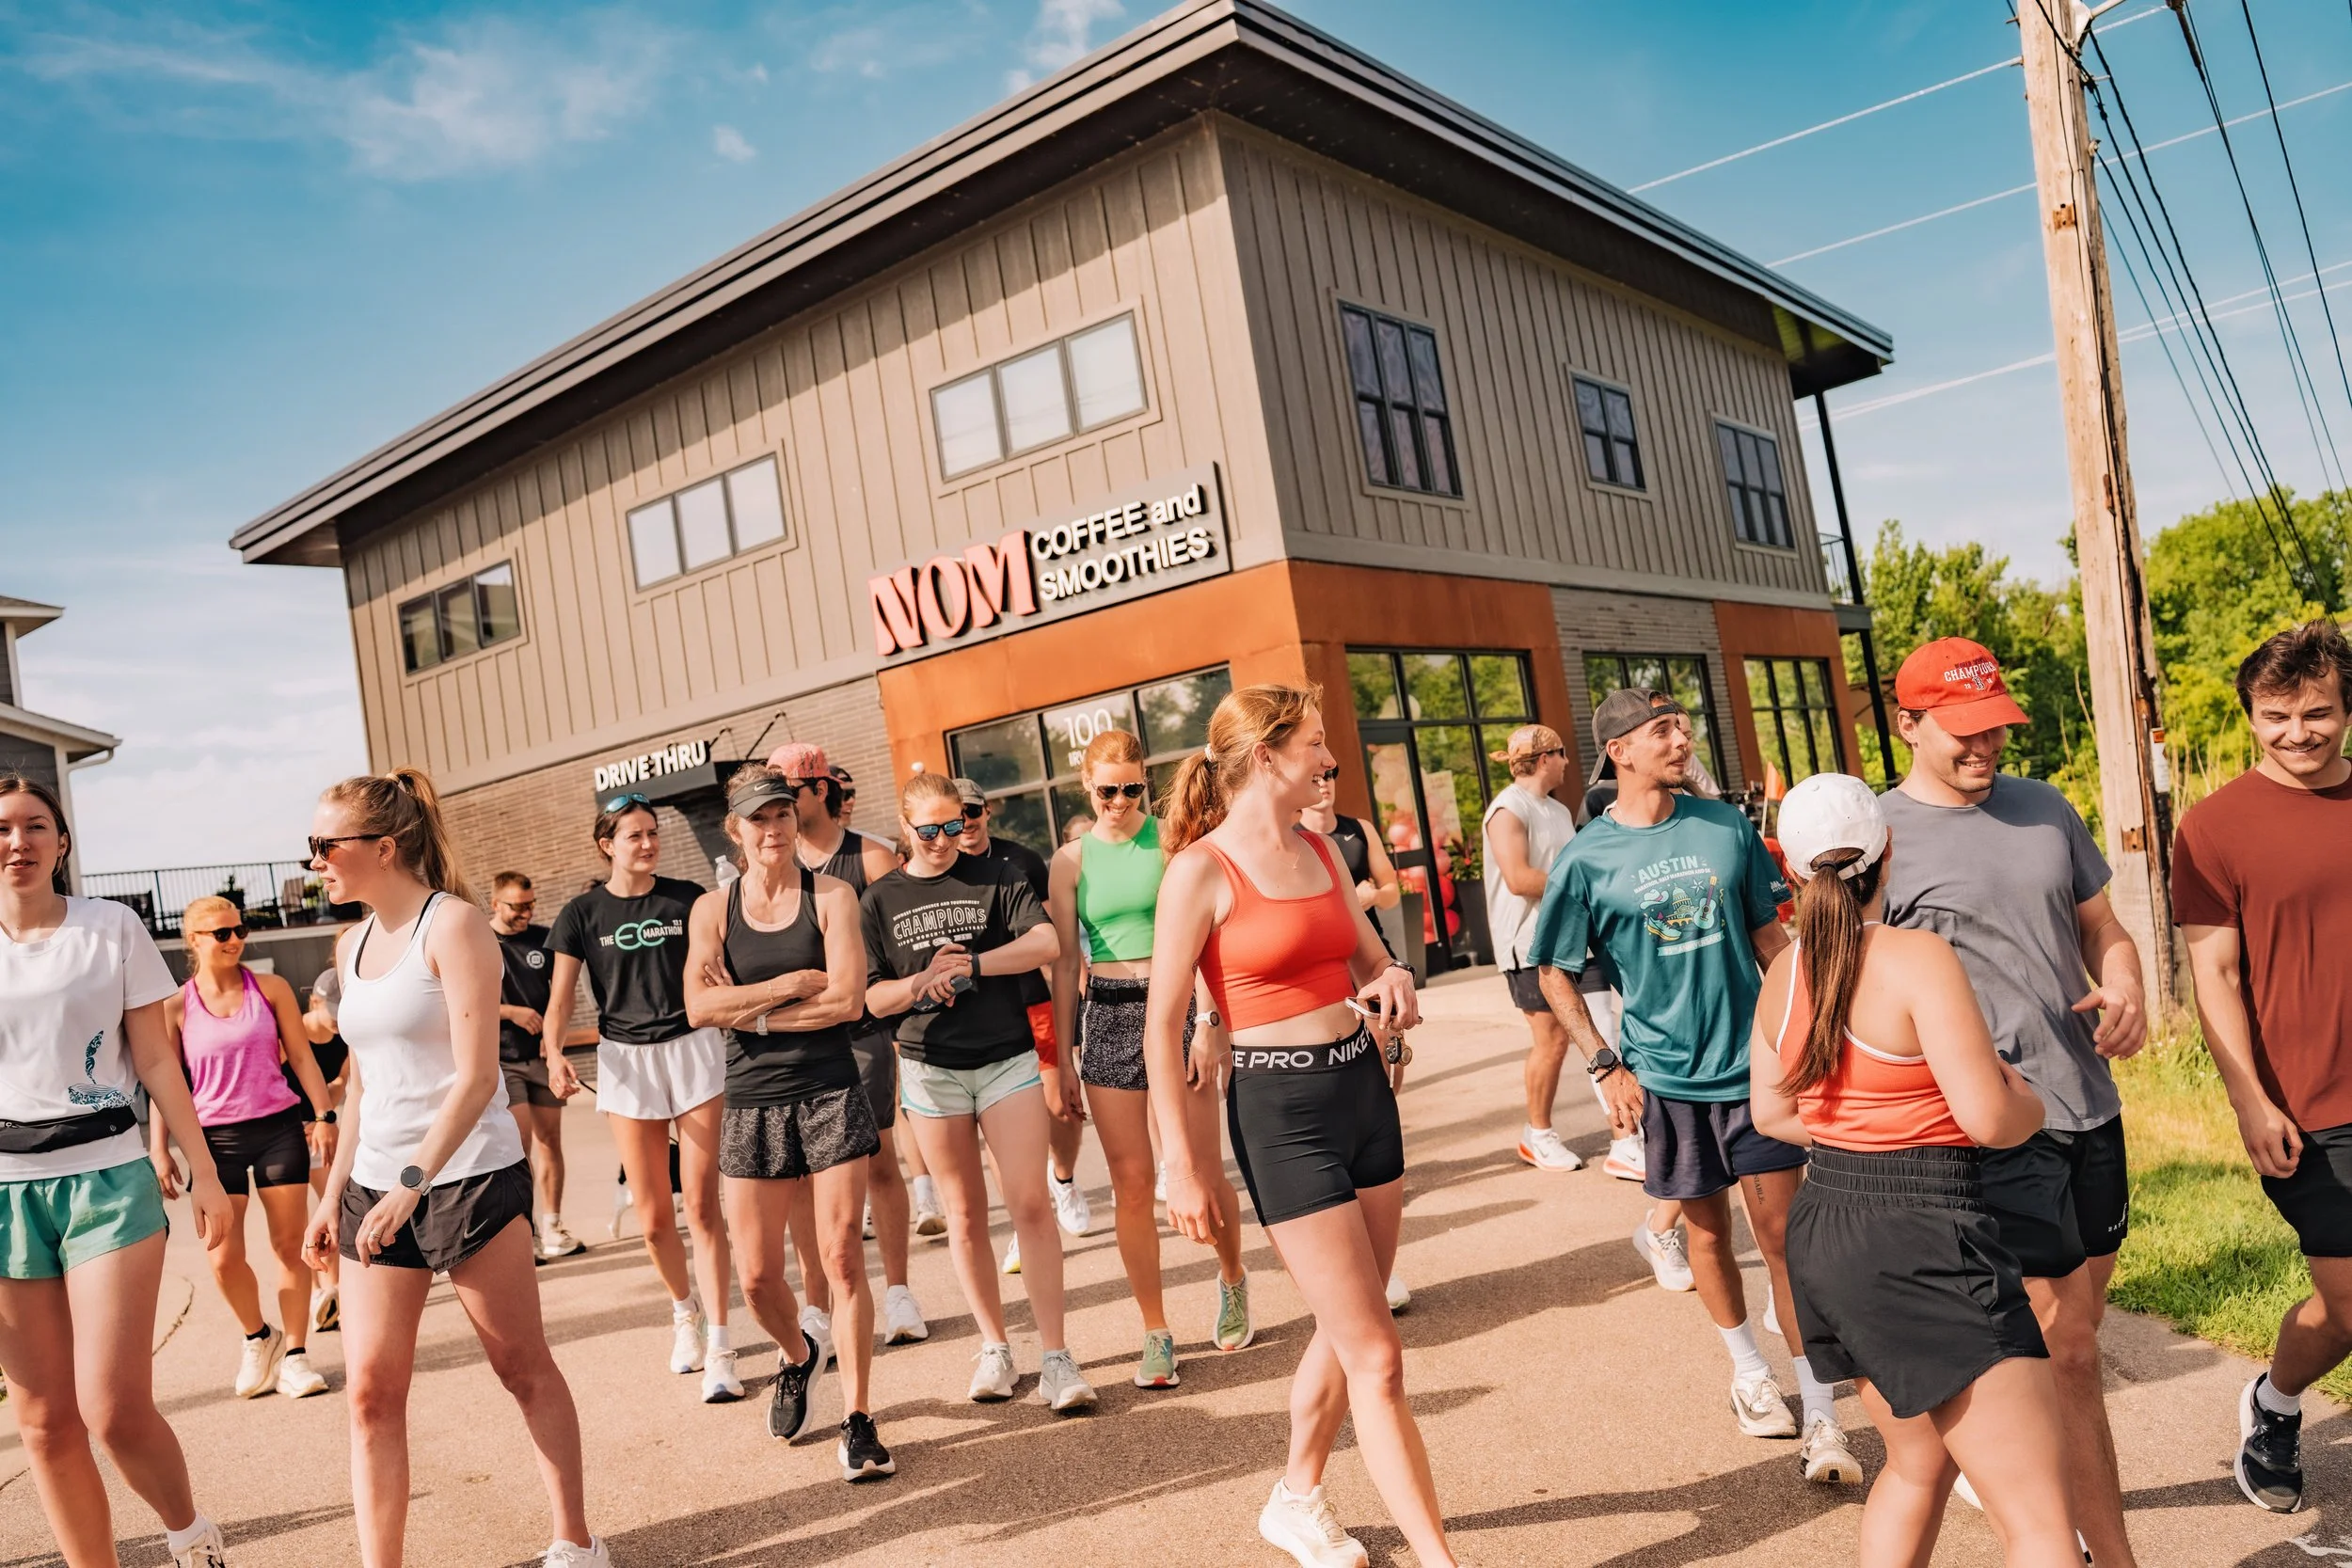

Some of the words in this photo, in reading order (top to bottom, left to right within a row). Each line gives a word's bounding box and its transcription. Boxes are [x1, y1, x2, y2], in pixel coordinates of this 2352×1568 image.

[1031, 501, 1144, 560] COFFEE
[1151, 483, 1202, 524] and
[1040, 527, 1211, 602] SMOOTHIES
[867, 530, 1037, 656] NOM
[1944, 661, 1996, 682] CHAMPIONS
[1064, 708, 1112, 748] 100
[594, 755, 651, 793] DRIVE
[652, 739, 707, 777] THRU
[1638, 855, 1698, 884] AUSTIN
[599, 935, 614, 946] THE
[643, 926, 683, 940] MARATHON
[894, 907, 987, 940] CHAMPIONS
[1248, 1051, 1314, 1069] PRO
[1328, 1029, 1368, 1066] NIKE
